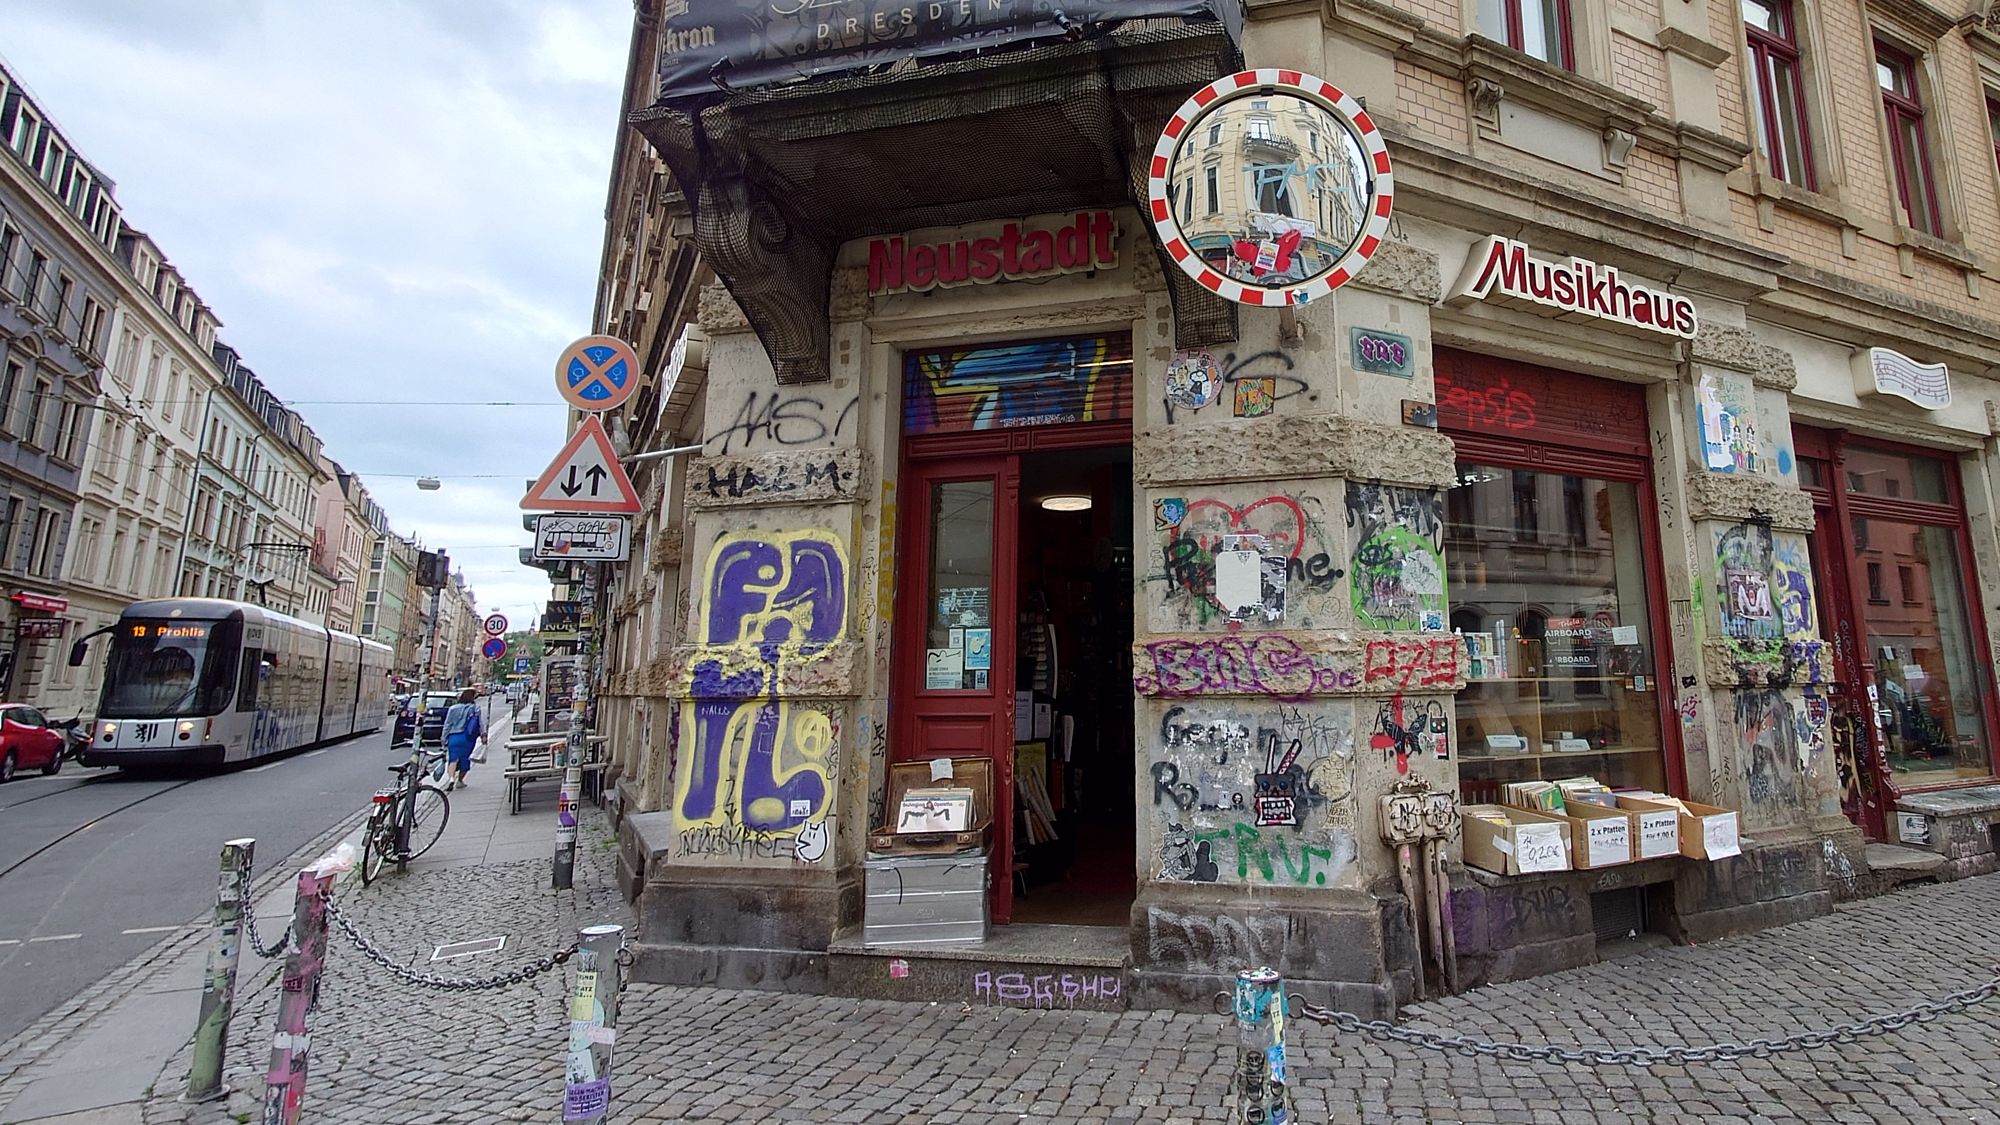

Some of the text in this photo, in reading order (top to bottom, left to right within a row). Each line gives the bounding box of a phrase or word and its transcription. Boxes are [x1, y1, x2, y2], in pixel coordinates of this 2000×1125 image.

[816, 0, 1001, 40] DRESDEN
[868, 211, 1115, 292] Neustadt
[1472, 240, 1696, 334] Musikhaus
[488, 619, 503, 631] 30
[132, 626, 205, 638] 13 Prohlis
[1544, 629, 1592, 638] AIRBOARD
[1602, 825, 1626, 835] Platten
[1655, 819, 1676, 829] Platten
